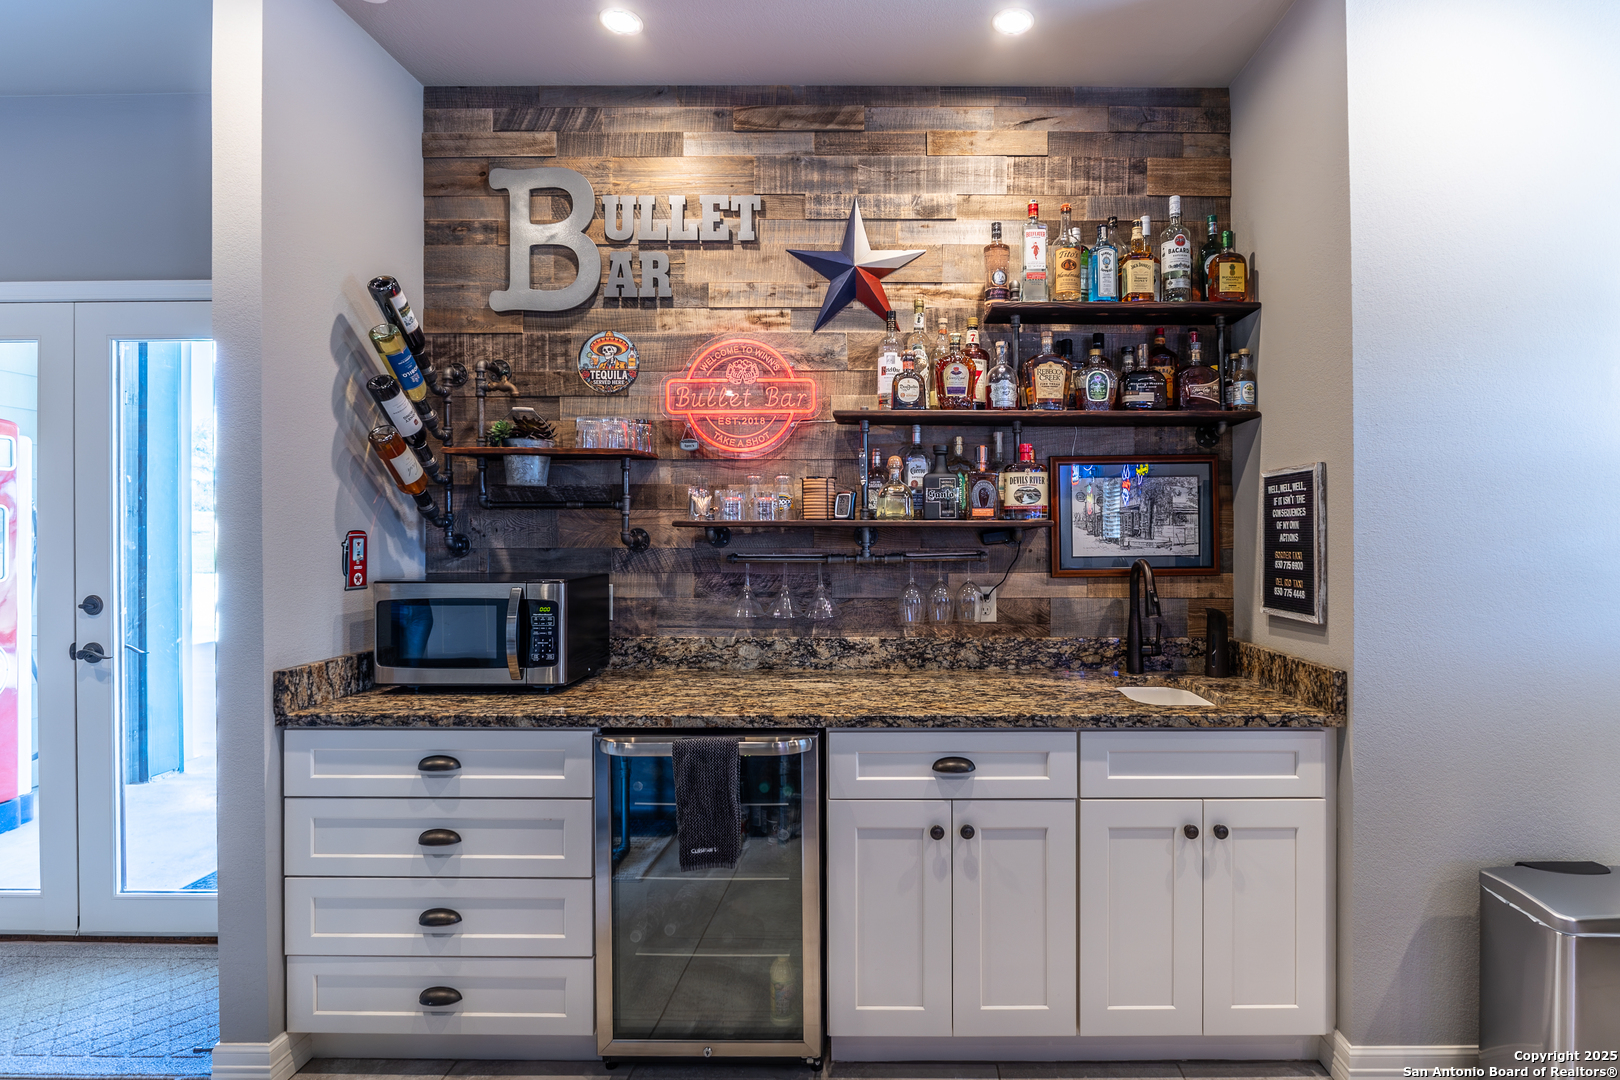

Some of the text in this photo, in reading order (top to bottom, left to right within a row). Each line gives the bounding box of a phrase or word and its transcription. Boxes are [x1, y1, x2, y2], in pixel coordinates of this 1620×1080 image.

[1058, 250, 1078, 259] Tito's
[970, 334, 976, 342] 7
[700, 345, 780, 372] WELCOME TO WINN'S
[590, 370, 628, 380] TEQUILA
[676, 386, 807, 407] Bullet Bar
[713, 431, 735, 446] TAKE
[746, 432, 770, 447] SHOT
[1010, 475, 1045, 485] DEVILS RIVER
[928, 490, 954, 500] Santo
[1296, 494, 1306, 504] THE
[1272, 507, 1306, 518] CONSEQUENCES
[1276, 521, 1282, 529] OF
[1283, 521, 1289, 529] MY
[1279, 533, 1299, 542] ACTIONS
